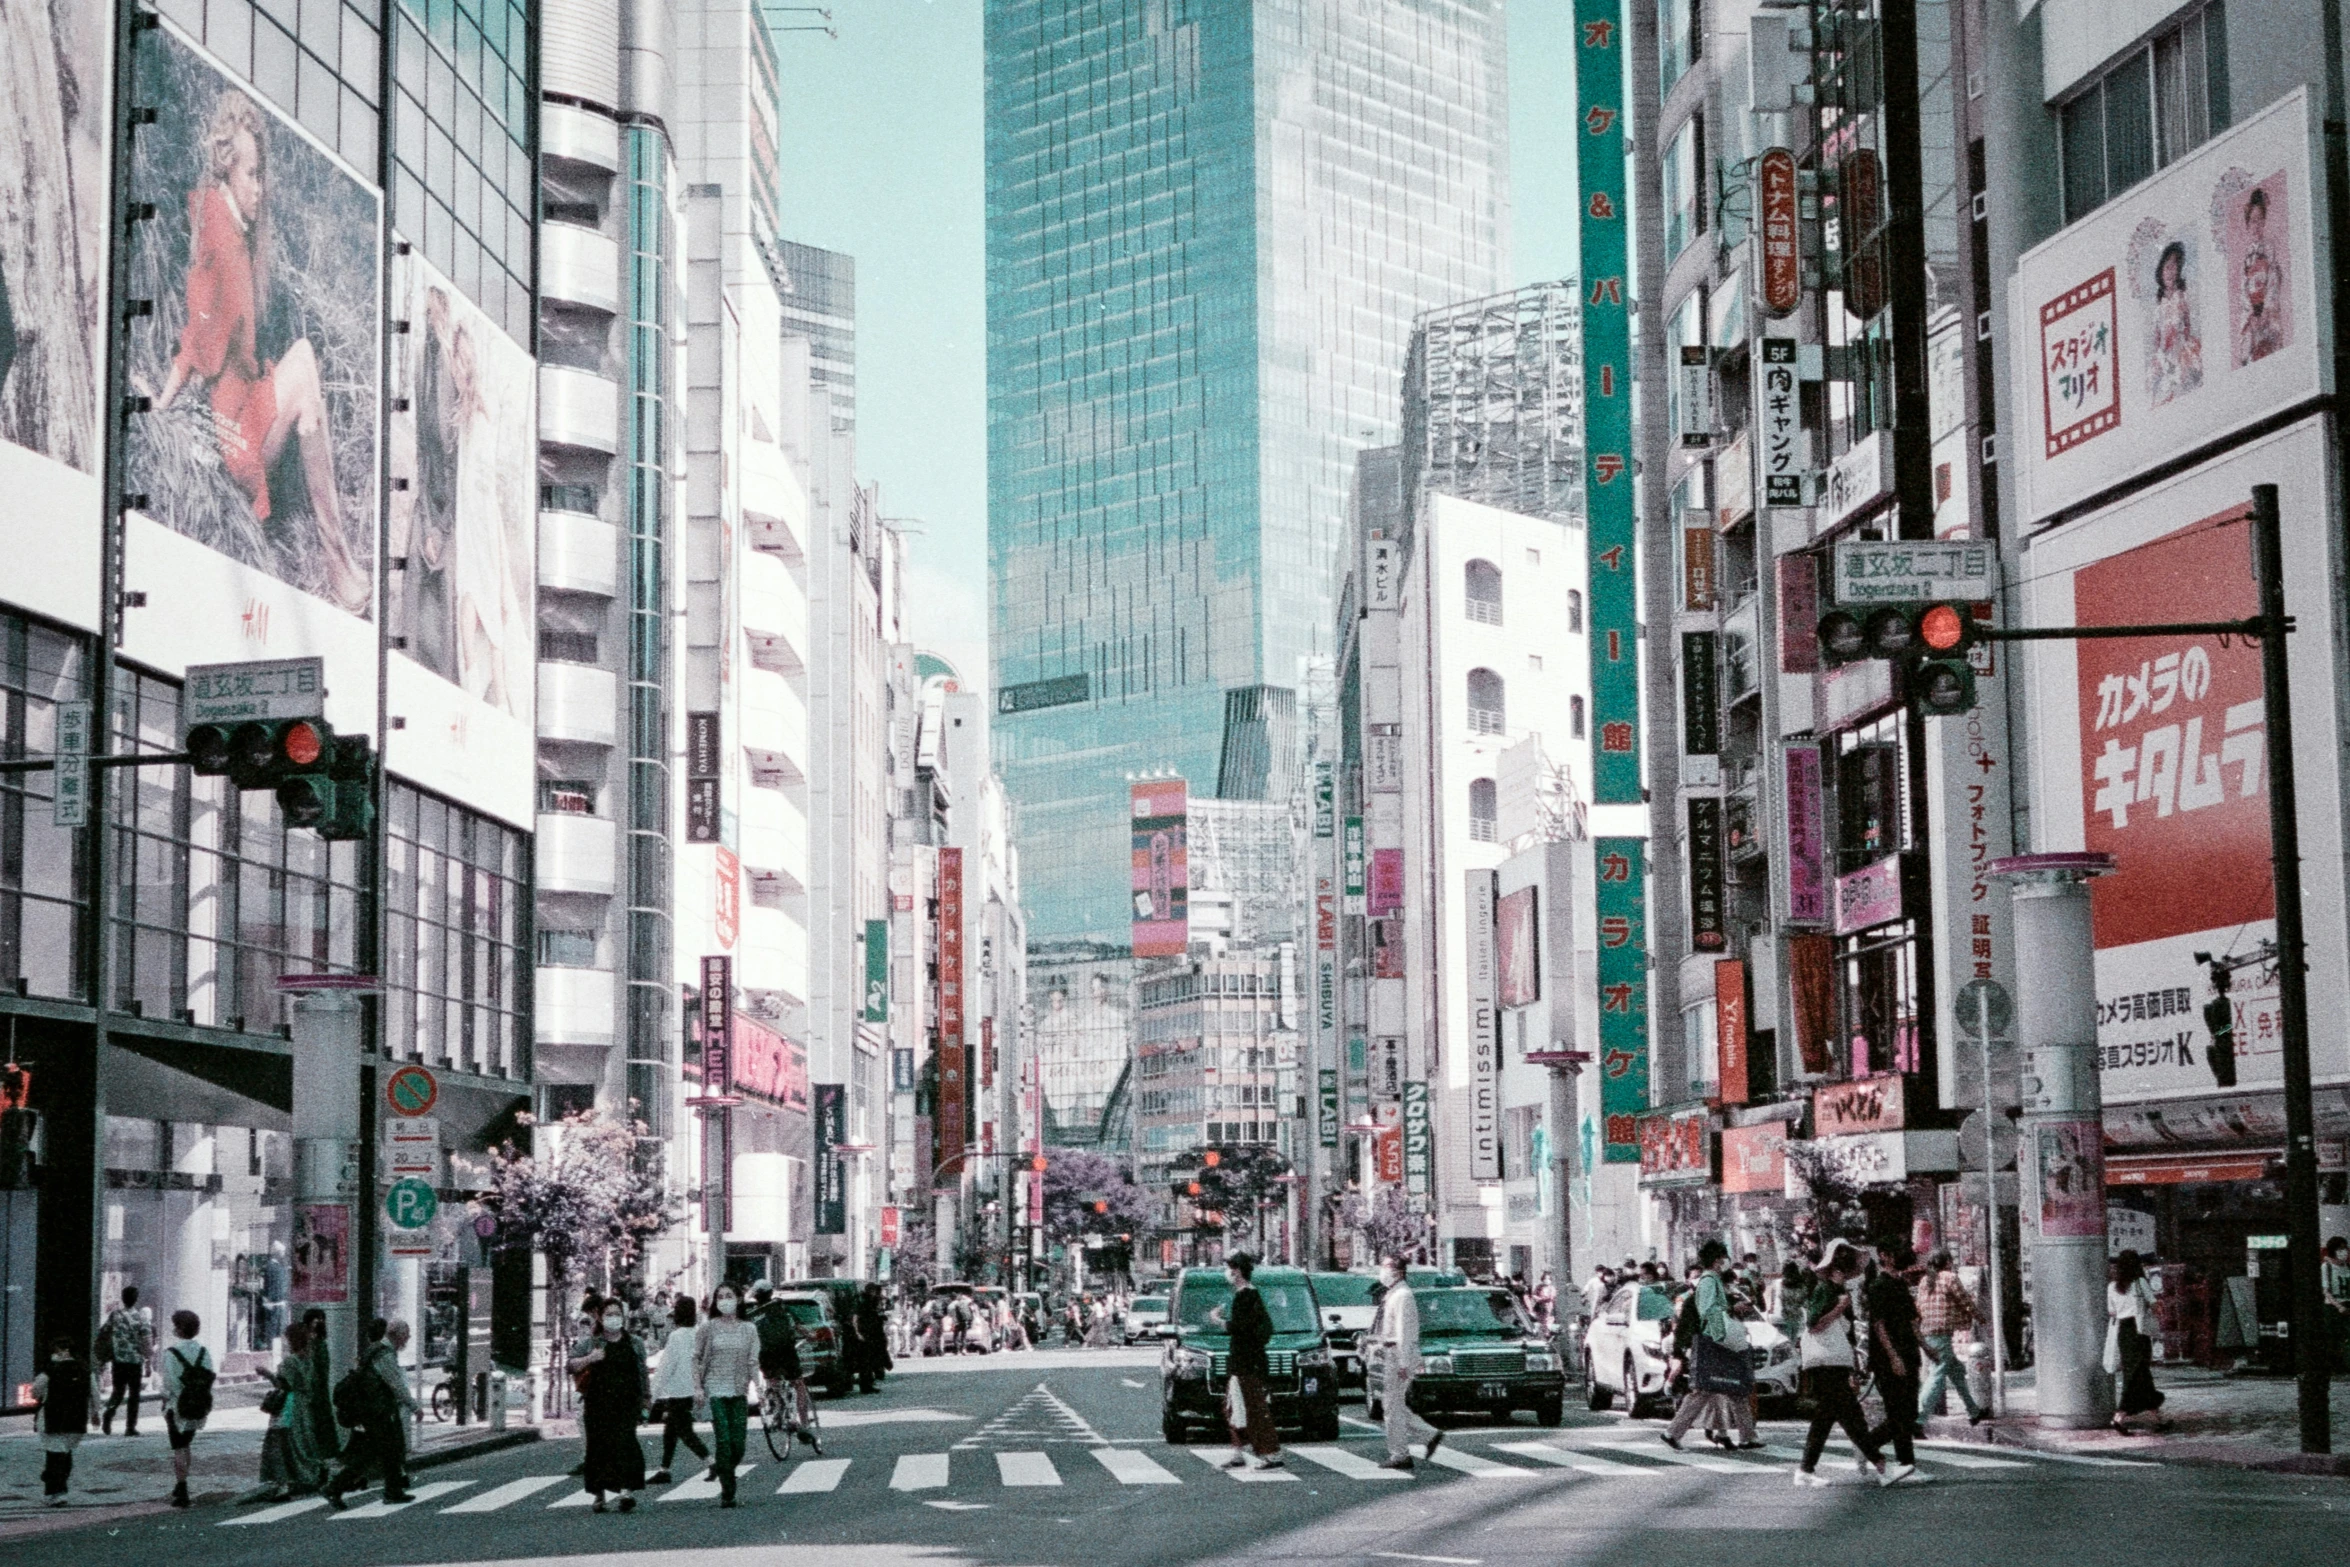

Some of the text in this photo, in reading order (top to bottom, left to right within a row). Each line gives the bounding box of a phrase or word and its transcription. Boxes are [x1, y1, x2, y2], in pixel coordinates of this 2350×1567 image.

[1763, 151, 1791, 256] ベトナム料理
[1771, 348, 1788, 361] 5F
[2051, 321, 2108, 374] スタジオ
[2058, 361, 2100, 410] マリオ
[1767, 366, 1792, 475] 肉ギャング
[1844, 549, 1985, 578] 道玄坂二丁目
[1848, 582, 1918, 598] Dogenzaka
[191, 666, 315, 700] 道玄坂二丁目
[2096, 645, 2211, 732] カメラの
[61, 710, 82, 819] 歩車分離式
[697, 718, 709, 774] KOMEHYO
[2094, 697, 2268, 831] キタムラ
[1317, 895, 1335, 950] LABI
[1321, 963, 1333, 1030] SHIBUYA
[1602, 853, 1637, 1145] カラオケ館
[1321, 1094, 1337, 1143] LABI
[397, 1189, 417, 1221] P
